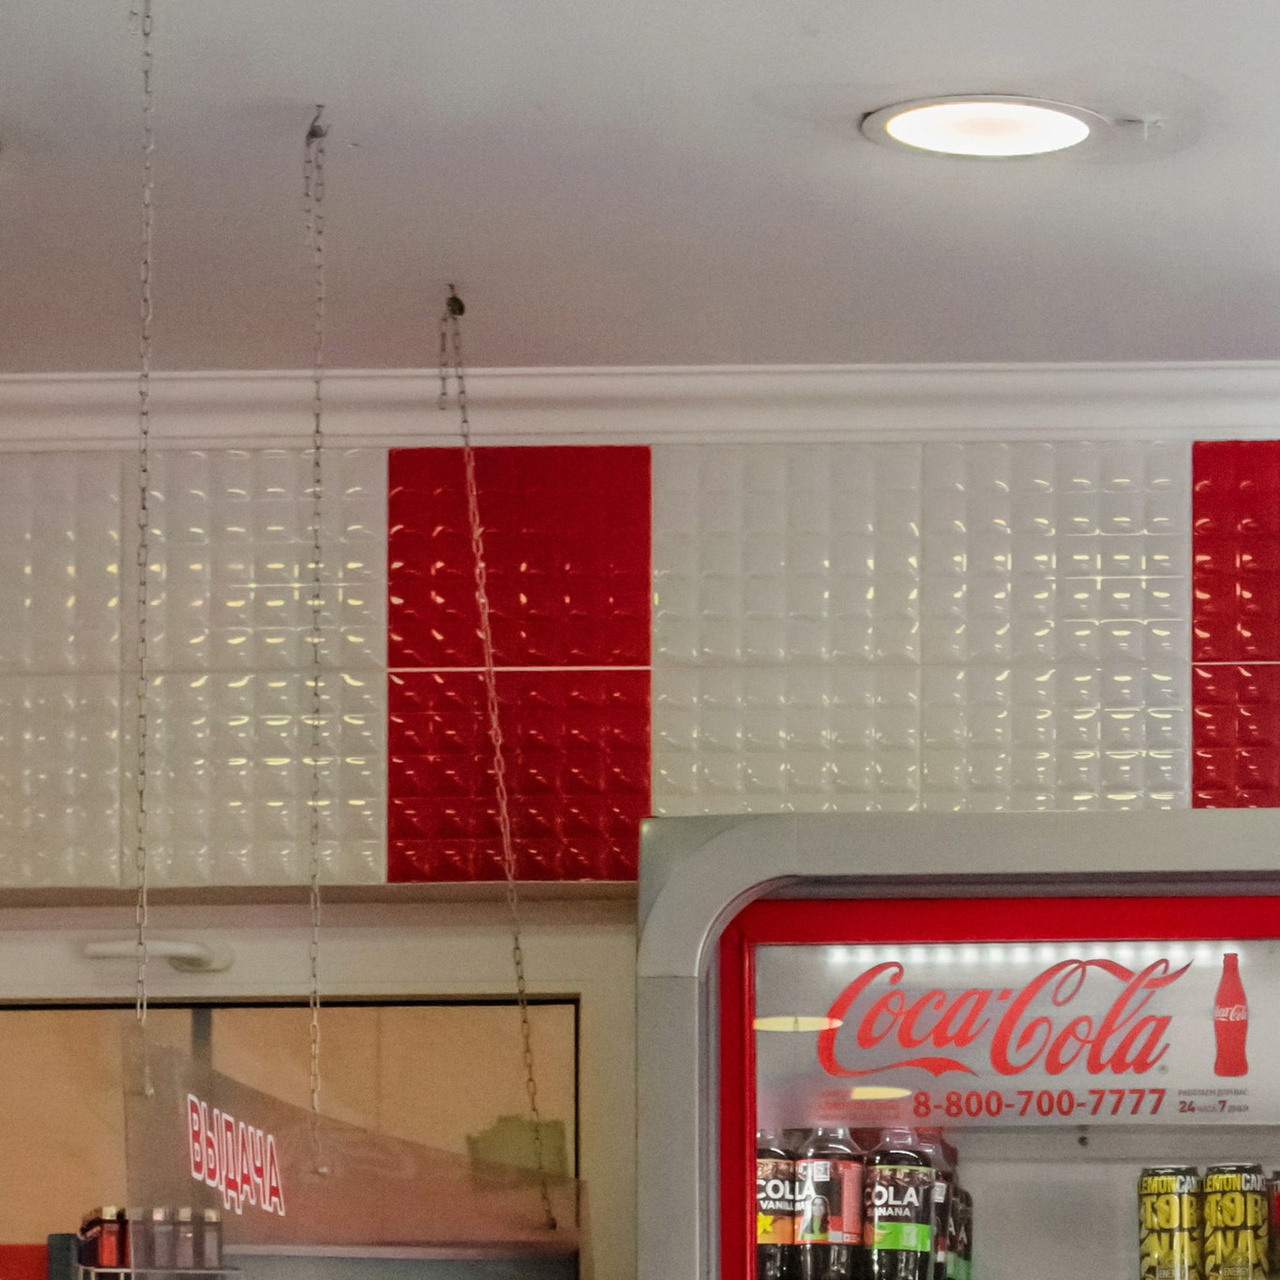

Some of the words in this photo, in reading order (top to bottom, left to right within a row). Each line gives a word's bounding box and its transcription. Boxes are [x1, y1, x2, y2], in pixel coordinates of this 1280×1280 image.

[817, 958, 1194, 1077] Coca-Cola
[913, 1088, 1167, 1117] 8-800-700-7777
[1179, 1101, 1196, 1113] 24
[1218, 1100, 1227, 1112] 7
[187, 1093, 286, 1217] ВЫДАЧА
